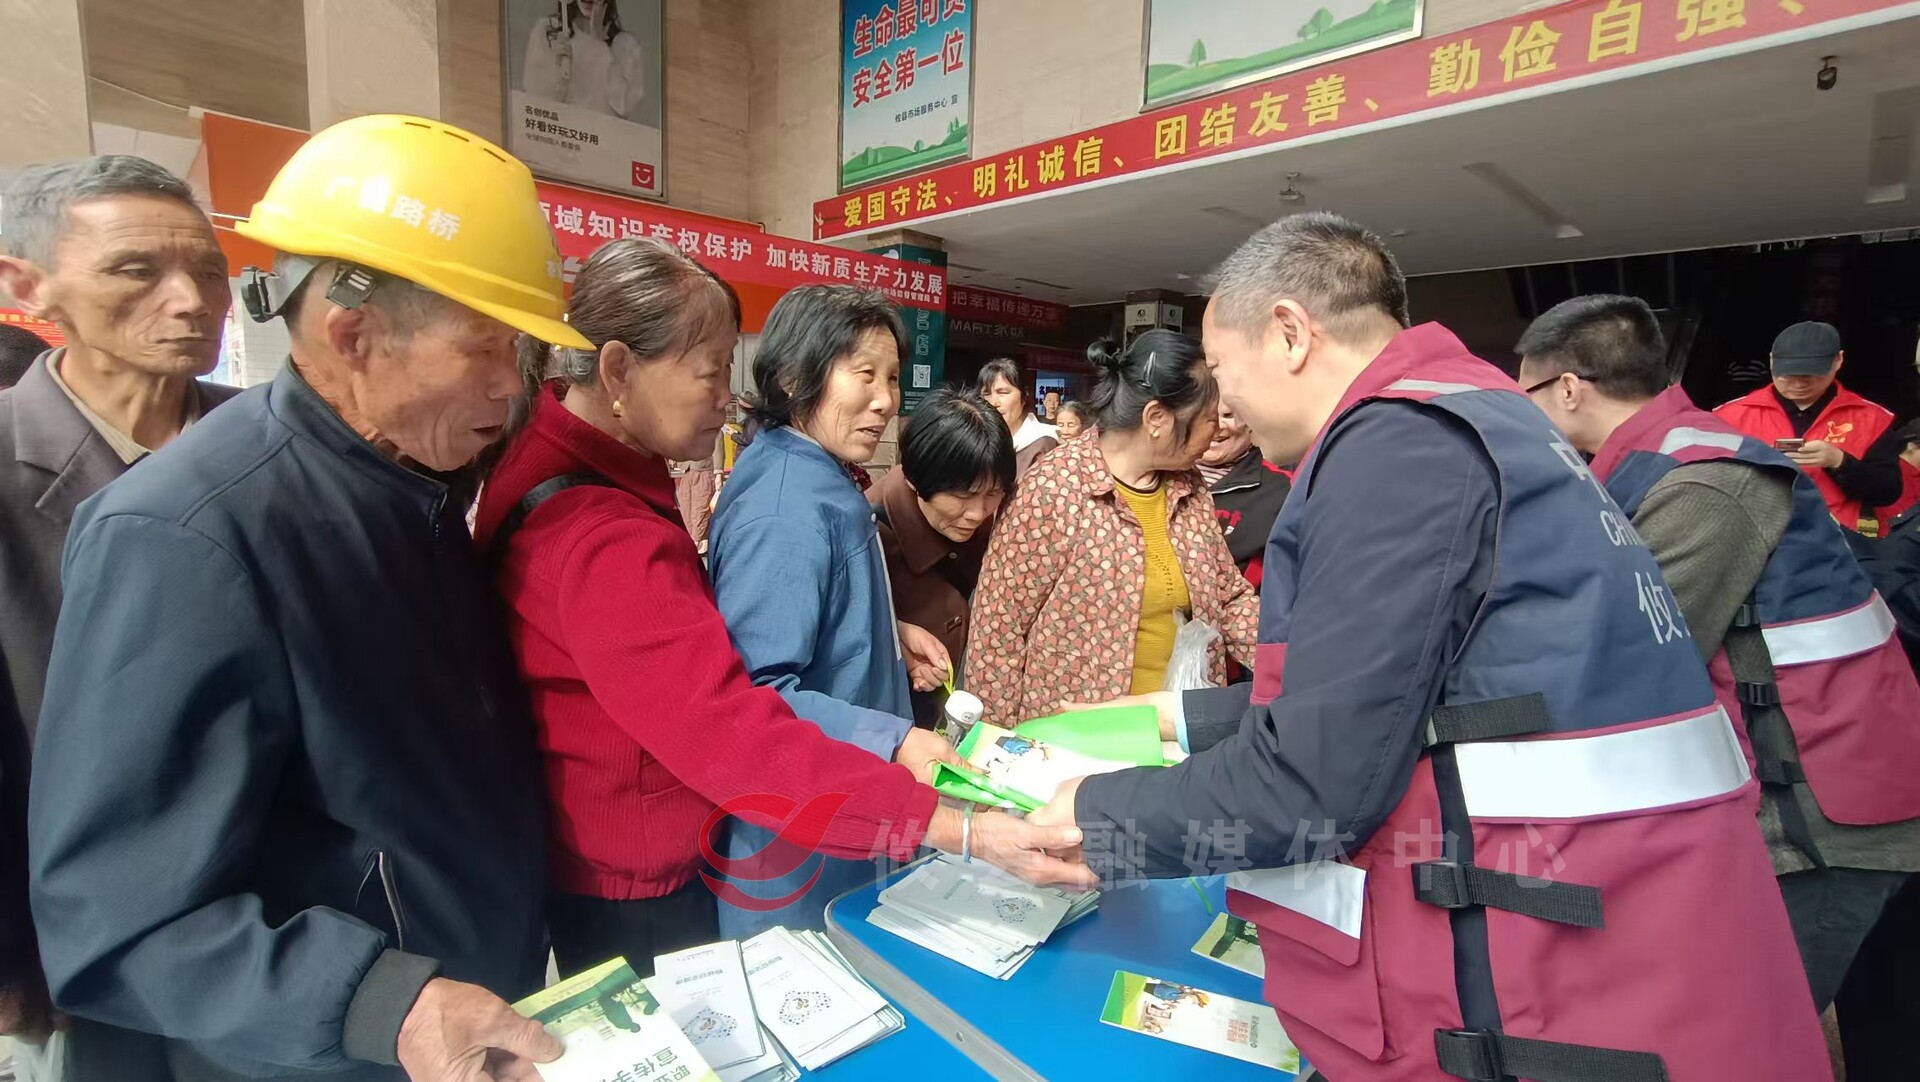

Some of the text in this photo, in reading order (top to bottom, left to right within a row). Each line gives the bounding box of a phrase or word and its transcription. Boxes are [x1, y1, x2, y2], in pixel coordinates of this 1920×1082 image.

[852, 28, 965, 109] 安全第一位
[524, 104, 559, 122] 名创优品
[525, 118, 599, 146] 好看好玩又好用
[766, 243, 943, 296] 加快新质生产力发展
[1635, 571, 1691, 645] 攸
[600, 1046, 678, 1082] 宣传手
